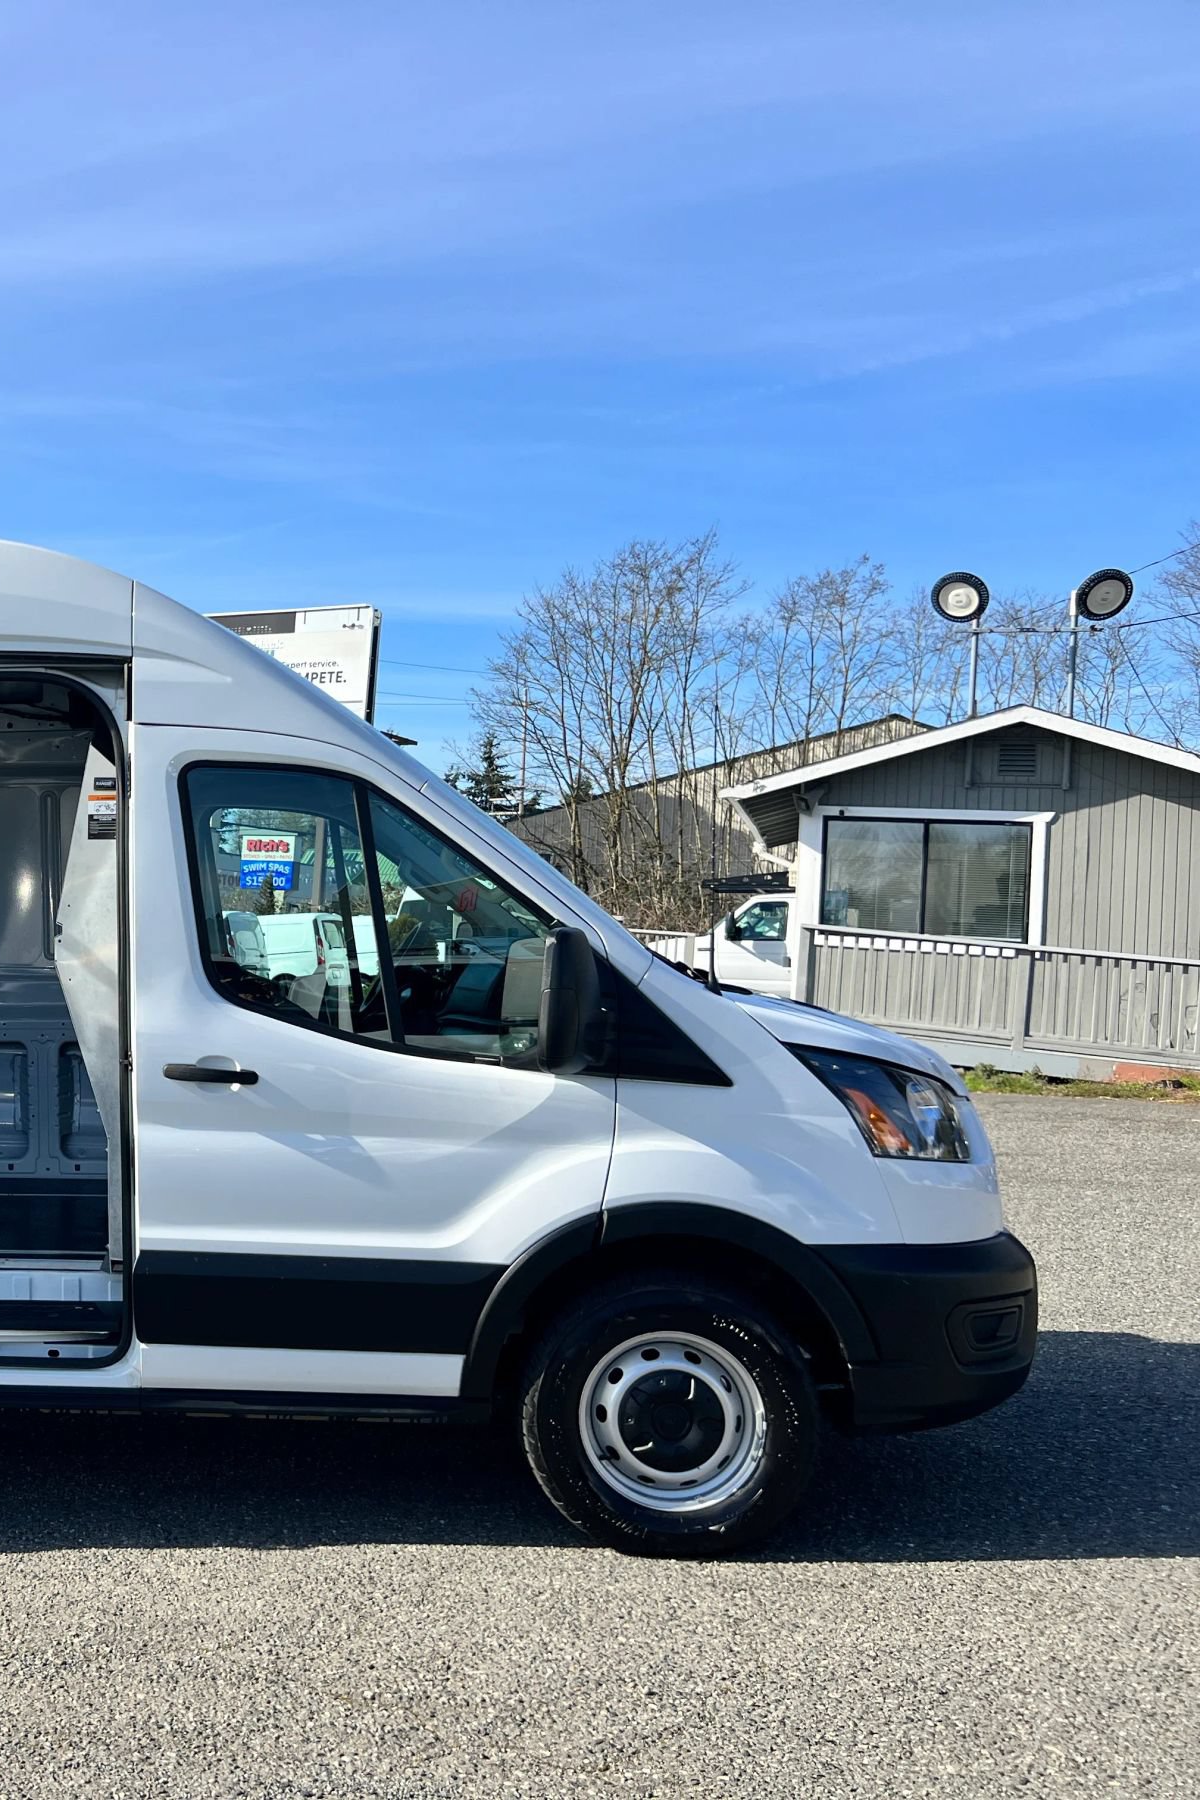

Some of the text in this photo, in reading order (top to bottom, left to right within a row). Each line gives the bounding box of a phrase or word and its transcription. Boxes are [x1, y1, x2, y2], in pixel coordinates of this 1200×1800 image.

[309, 660, 340, 668] service.
[243, 863, 290, 874] SWIM SPAS
